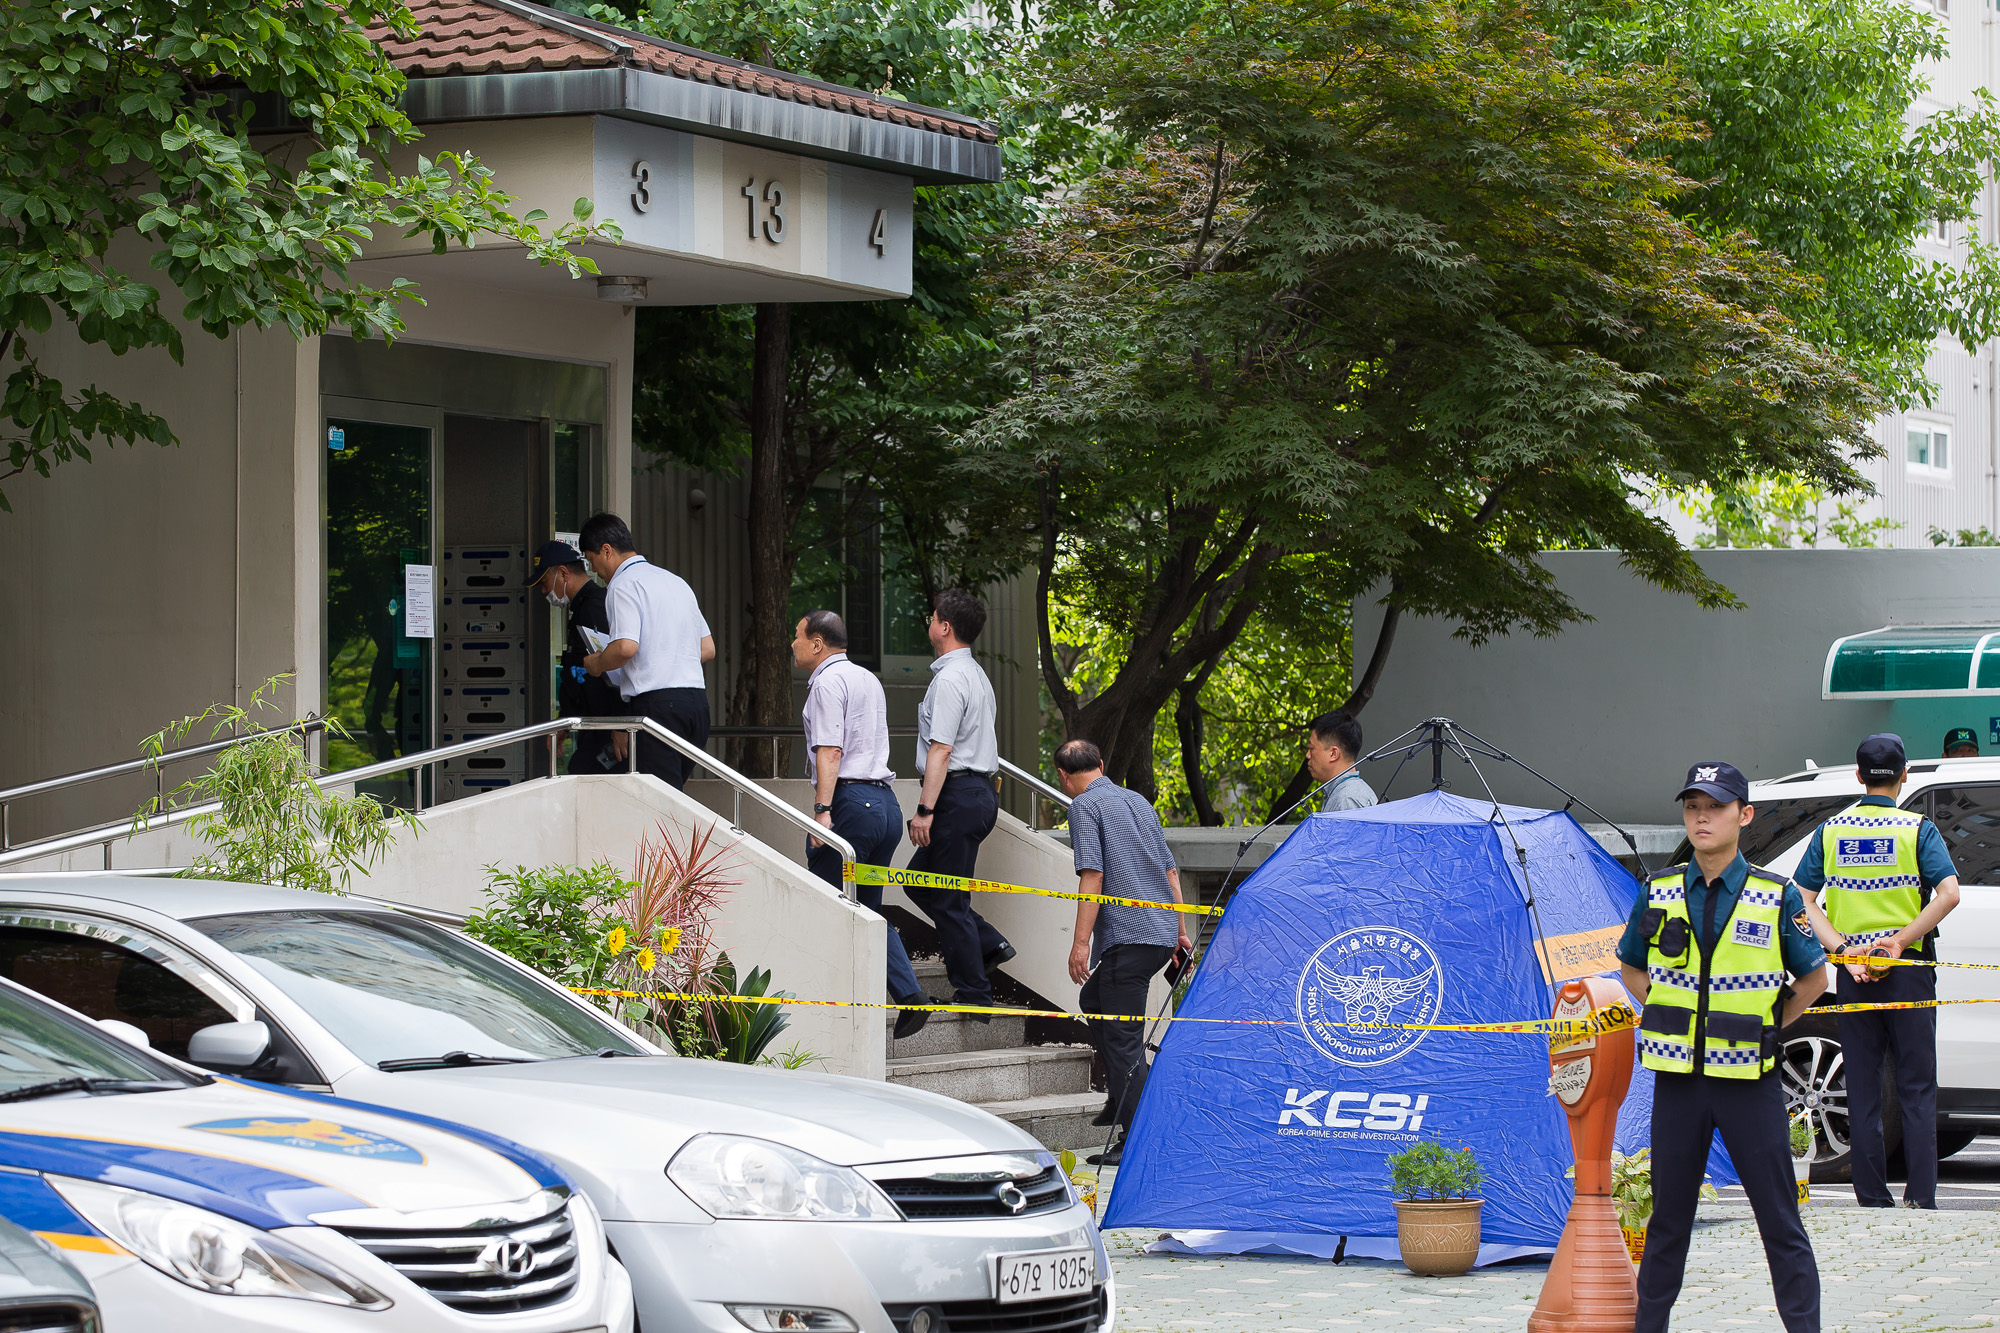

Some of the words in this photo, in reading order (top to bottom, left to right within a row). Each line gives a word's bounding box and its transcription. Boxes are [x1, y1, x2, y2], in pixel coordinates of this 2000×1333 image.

[631, 160, 654, 214] 3
[741, 177, 788, 244] 13
[869, 208, 889, 257] 4
[1336, 934, 1422, 961] 서울지방경찰청
[1736, 934, 1767, 946] POLICE
[1307, 986, 1318, 1018] SEOUL
[1313, 1018, 1377, 1056] METROPOLITAN
[1379, 1030, 1413, 1054] POLICE
[1278, 1088, 1430, 1132] KCSI
[1277, 1128, 1304, 1136] KOREA
[1306, 1129, 1331, 1138] CRIME
[1332, 1131, 1359, 1139] SCENE
[1360, 1132, 1419, 1142] INVESTIGATION
[1010, 1263, 1041, 1294] 67오
[1050, 1256, 1086, 1290] 1825
